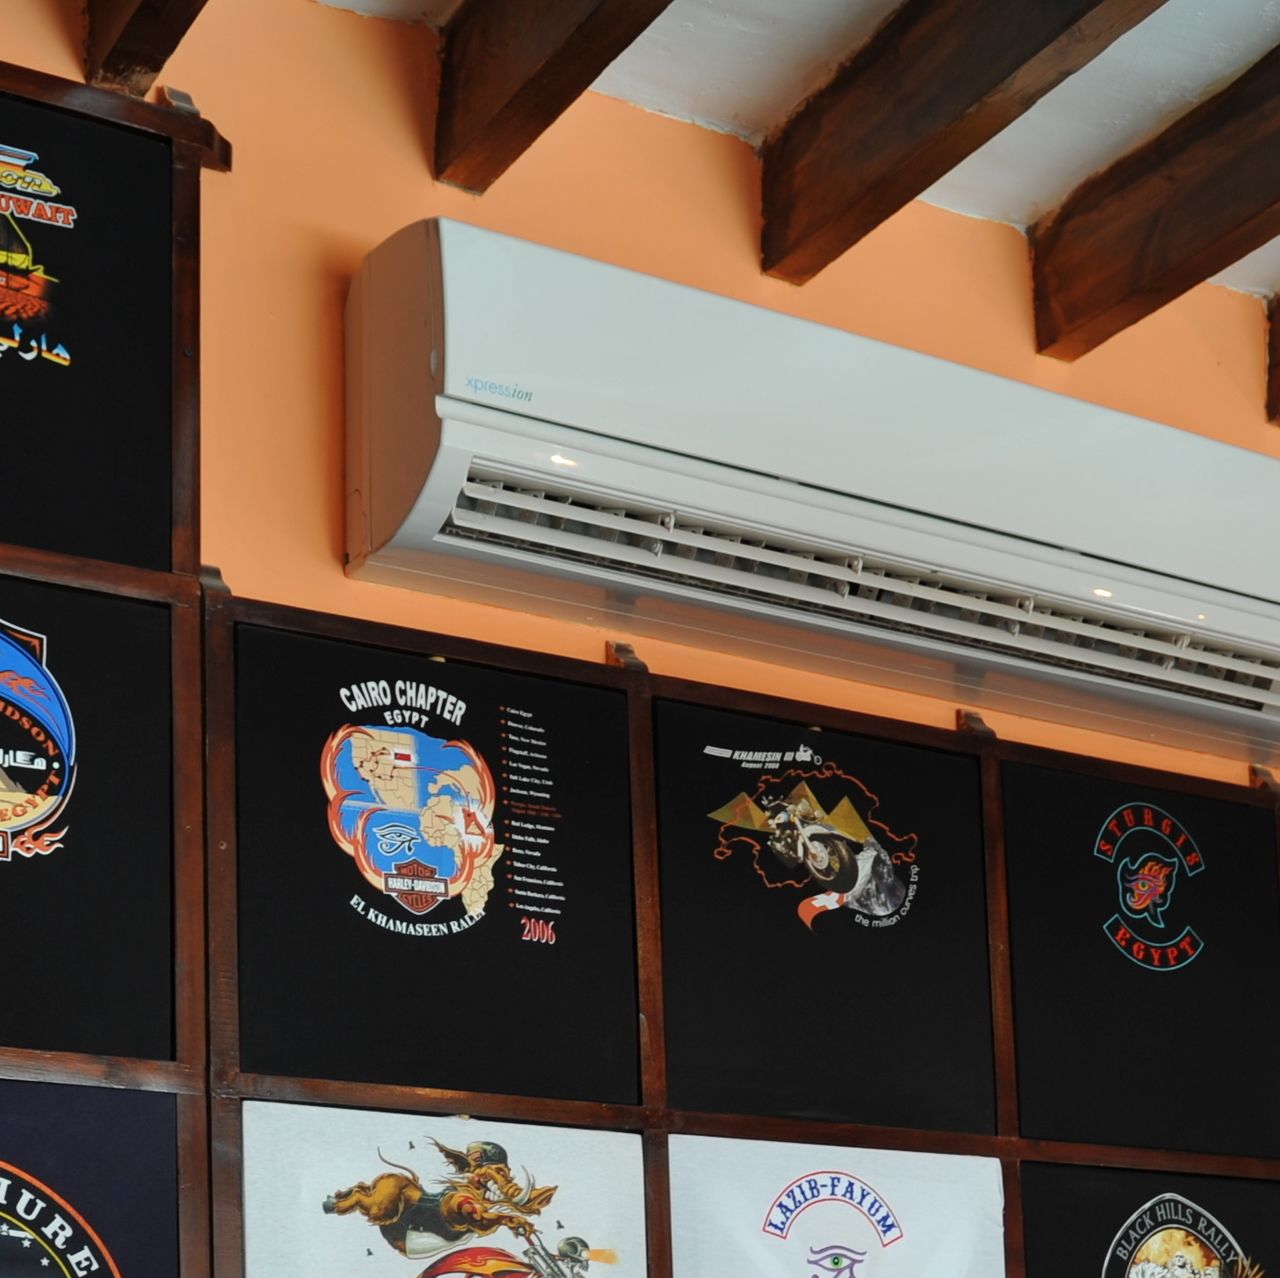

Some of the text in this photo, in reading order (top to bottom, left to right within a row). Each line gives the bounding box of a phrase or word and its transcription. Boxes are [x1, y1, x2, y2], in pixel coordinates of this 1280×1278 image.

[465, 375, 533, 403] xpression
[339, 680, 467, 726] CAIRO CHAPTER
[383, 709, 430, 729] EGYPT
[732, 750, 783, 762] KHAMESIN
[1099, 808, 1200, 867] STURGIS
[387, 876, 446, 894] HARLEY-DAVIDSON
[349, 894, 366, 915] EL
[367, 909, 449, 937] KHAMASEEN
[520, 916, 557, 945] 2006
[854, 912, 870, 928] the
[871, 913, 901, 928] million
[1114, 926, 1196, 966] EGYPT
[768, 1176, 897, 1237] LAZIB-FAYUM
[1116, 1202, 1239, 1264] BLACK HILLS RALLY
